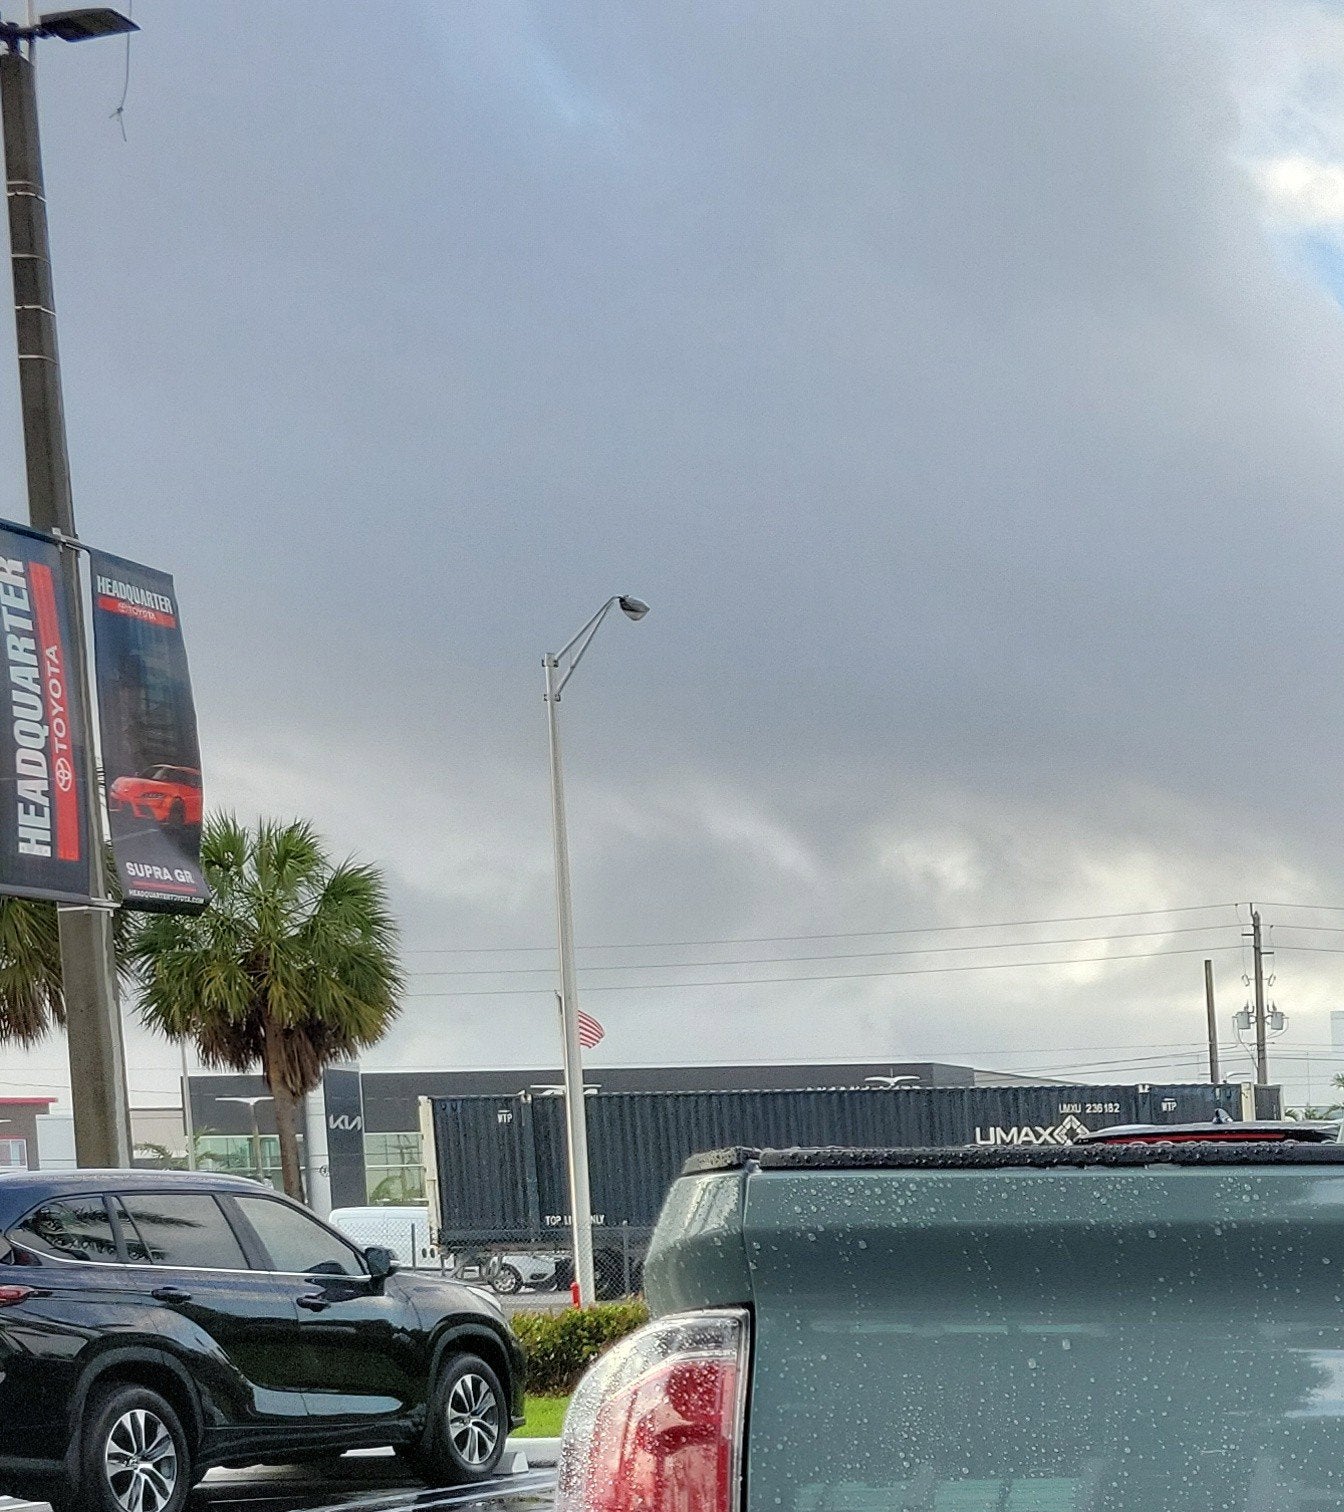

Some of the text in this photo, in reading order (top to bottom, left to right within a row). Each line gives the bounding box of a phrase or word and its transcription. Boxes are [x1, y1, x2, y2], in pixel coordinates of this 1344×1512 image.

[96, 574, 174, 614] HEADQUARTER
[0, 556, 52, 857] HEADQUARTER
[45, 644, 68, 754] TOYOTA
[125, 861, 195, 884] SUPRA GR
[328, 1114, 362, 1131] KIA
[975, 1126, 1057, 1145] UMAX
